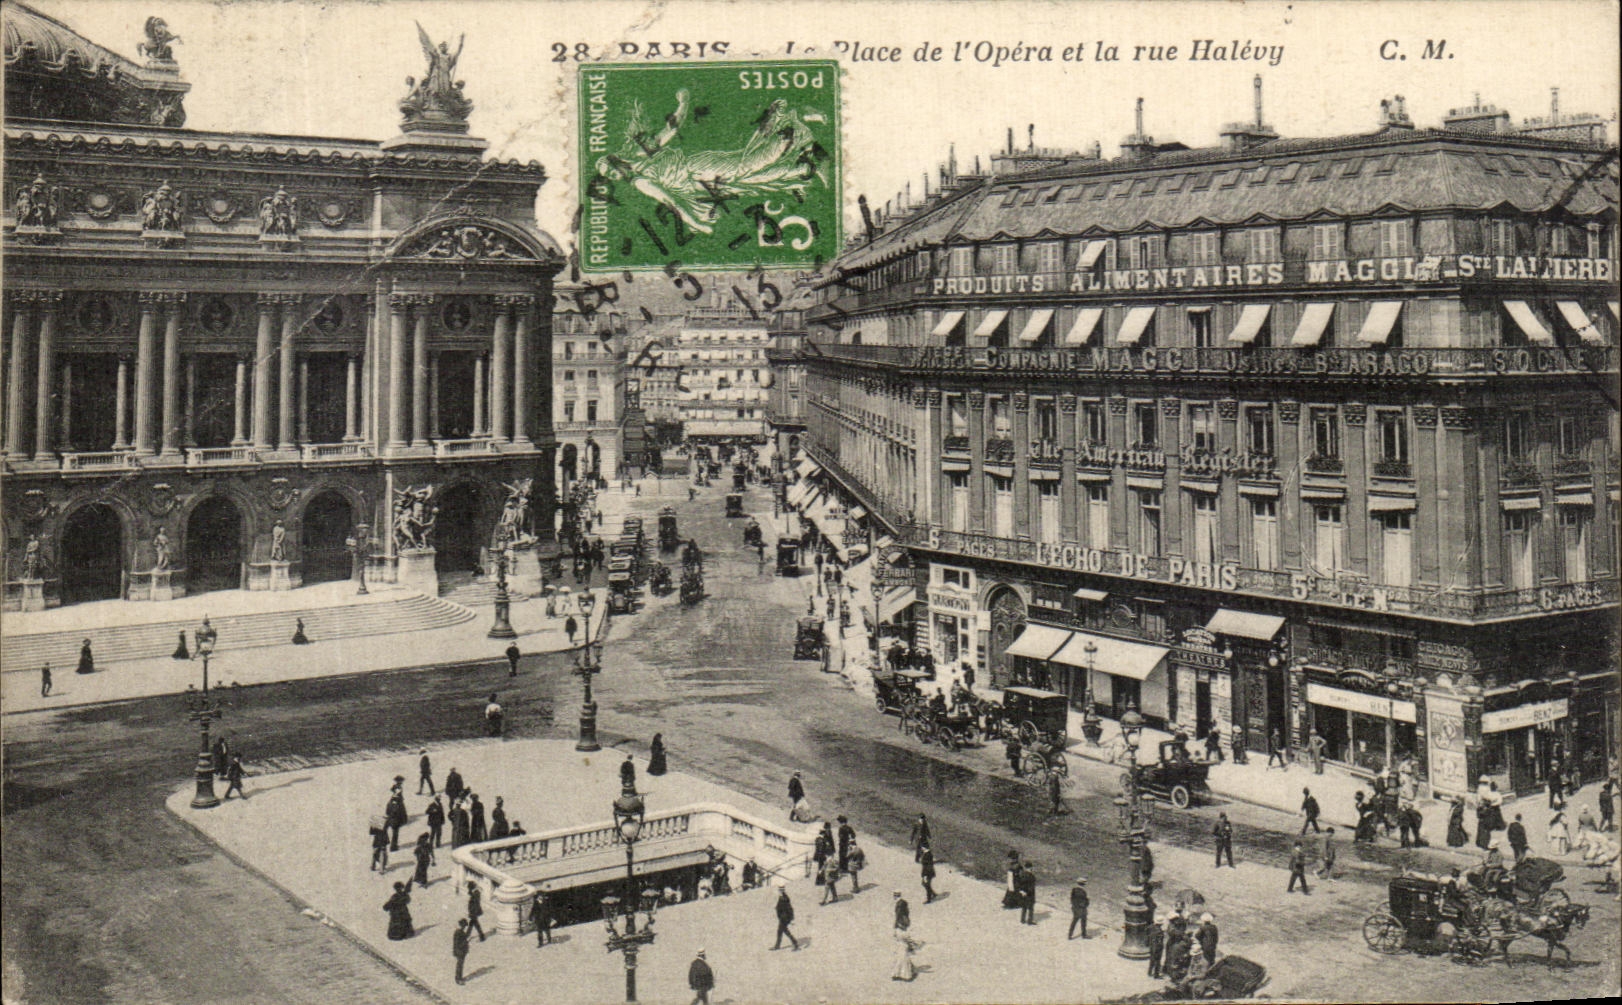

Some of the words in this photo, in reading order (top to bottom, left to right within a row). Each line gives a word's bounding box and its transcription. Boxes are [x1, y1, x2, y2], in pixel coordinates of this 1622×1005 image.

[738, 71, 824, 90] POSTES
[589, 73, 608, 153] FRANÇAISE
[933, 274, 1045, 295] PRODUITS
[1070, 263, 1285, 292] ALIMENTAIRES
[1308, 257, 1415, 282] MAGGI
[1091, 347, 1199, 371] MAGGI
[1036, 543, 1102, 572] L'ECHO
[1122, 554, 1149, 579] DE
[1169, 560, 1238, 590] PARIS
